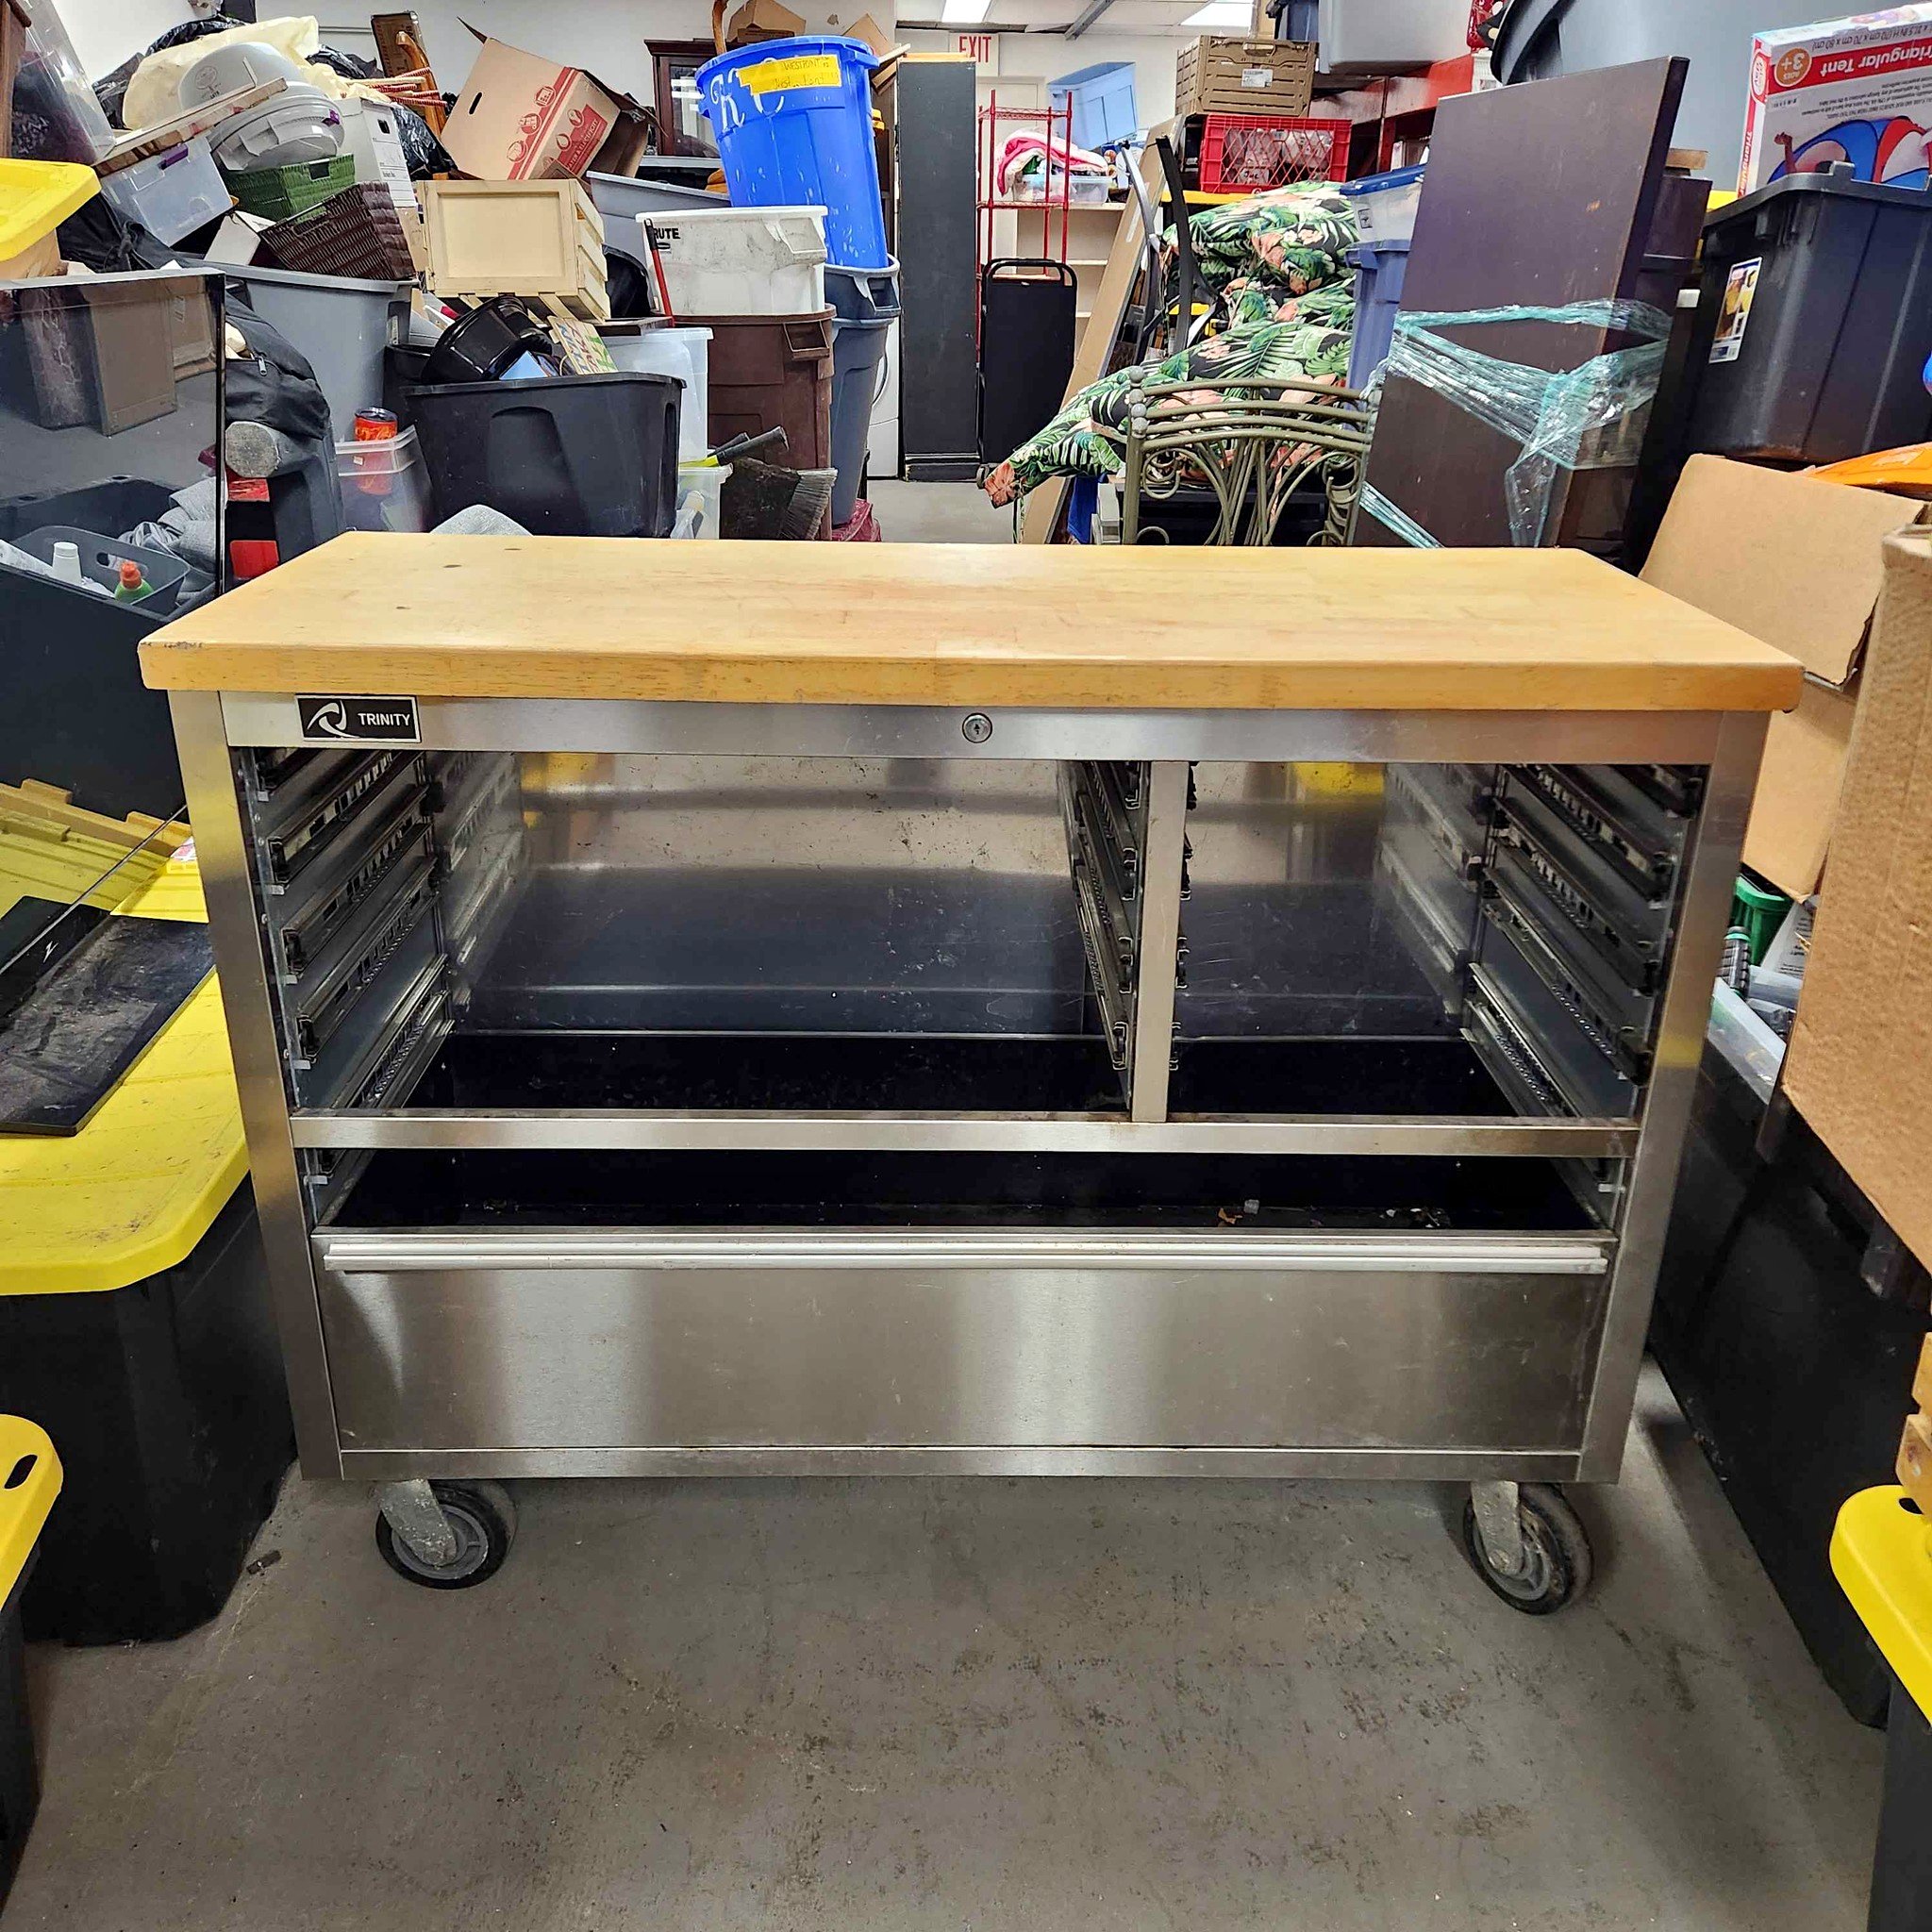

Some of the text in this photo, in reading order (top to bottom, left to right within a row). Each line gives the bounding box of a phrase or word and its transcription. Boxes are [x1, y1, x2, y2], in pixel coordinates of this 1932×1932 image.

[959, 36, 991, 63] EXIT
[1780, 53, 1804, 71] 3+
[1821, 43, 1932, 77] riangular Tent
[653, 228, 681, 240] RUTE
[358, 712, 410, 726] TRINITY
